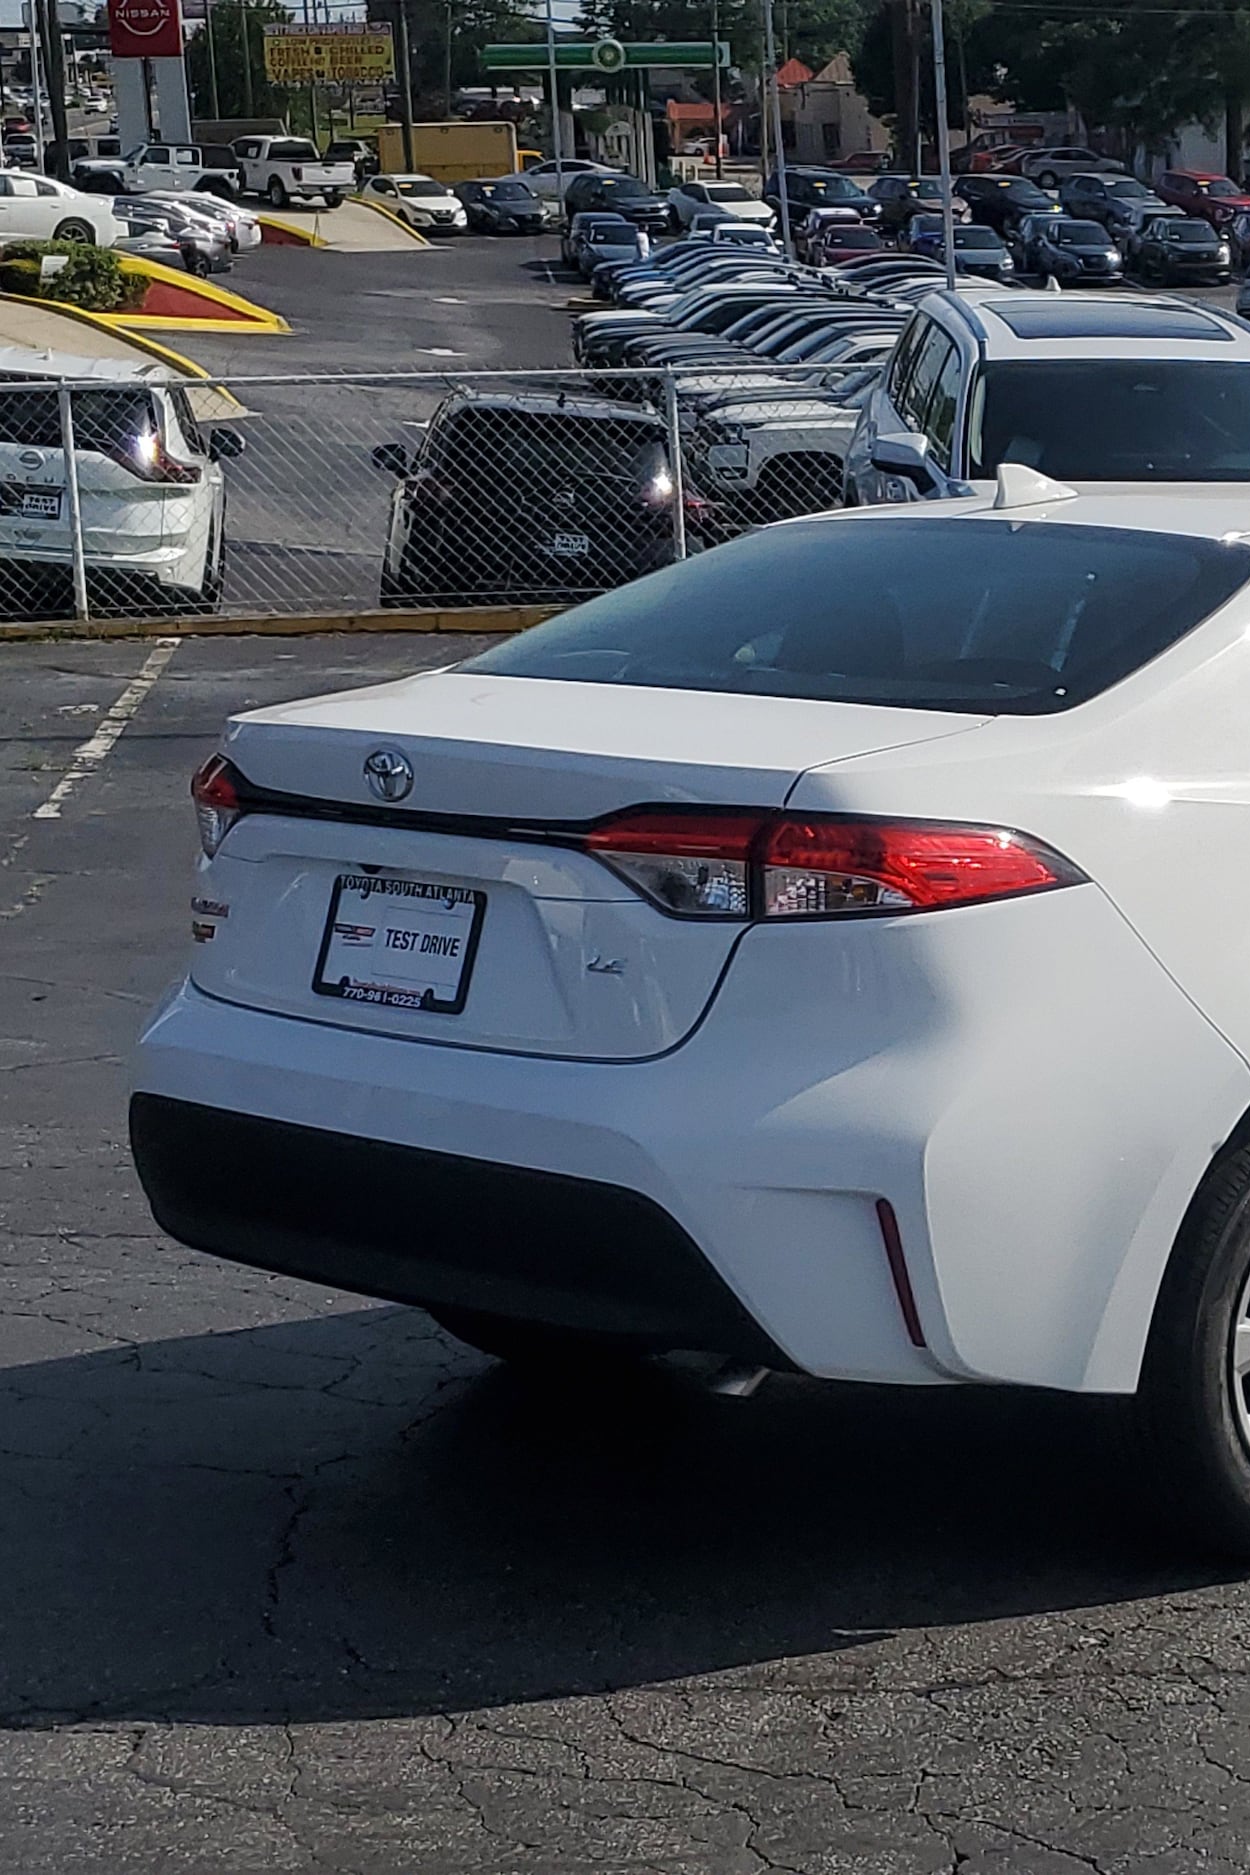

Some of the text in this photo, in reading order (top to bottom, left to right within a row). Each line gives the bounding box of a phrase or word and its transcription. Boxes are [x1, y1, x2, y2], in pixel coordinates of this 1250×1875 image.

[115, 9, 170, 18] NISSAN
[329, 45, 385, 55] CHILLED
[332, 66, 384, 80] TOBACCO
[340, 875, 475, 905] TOYOTA SOUTH ATLANTA
[385, 928, 420, 951] TEST
[420, 934, 461, 957] DRIVE
